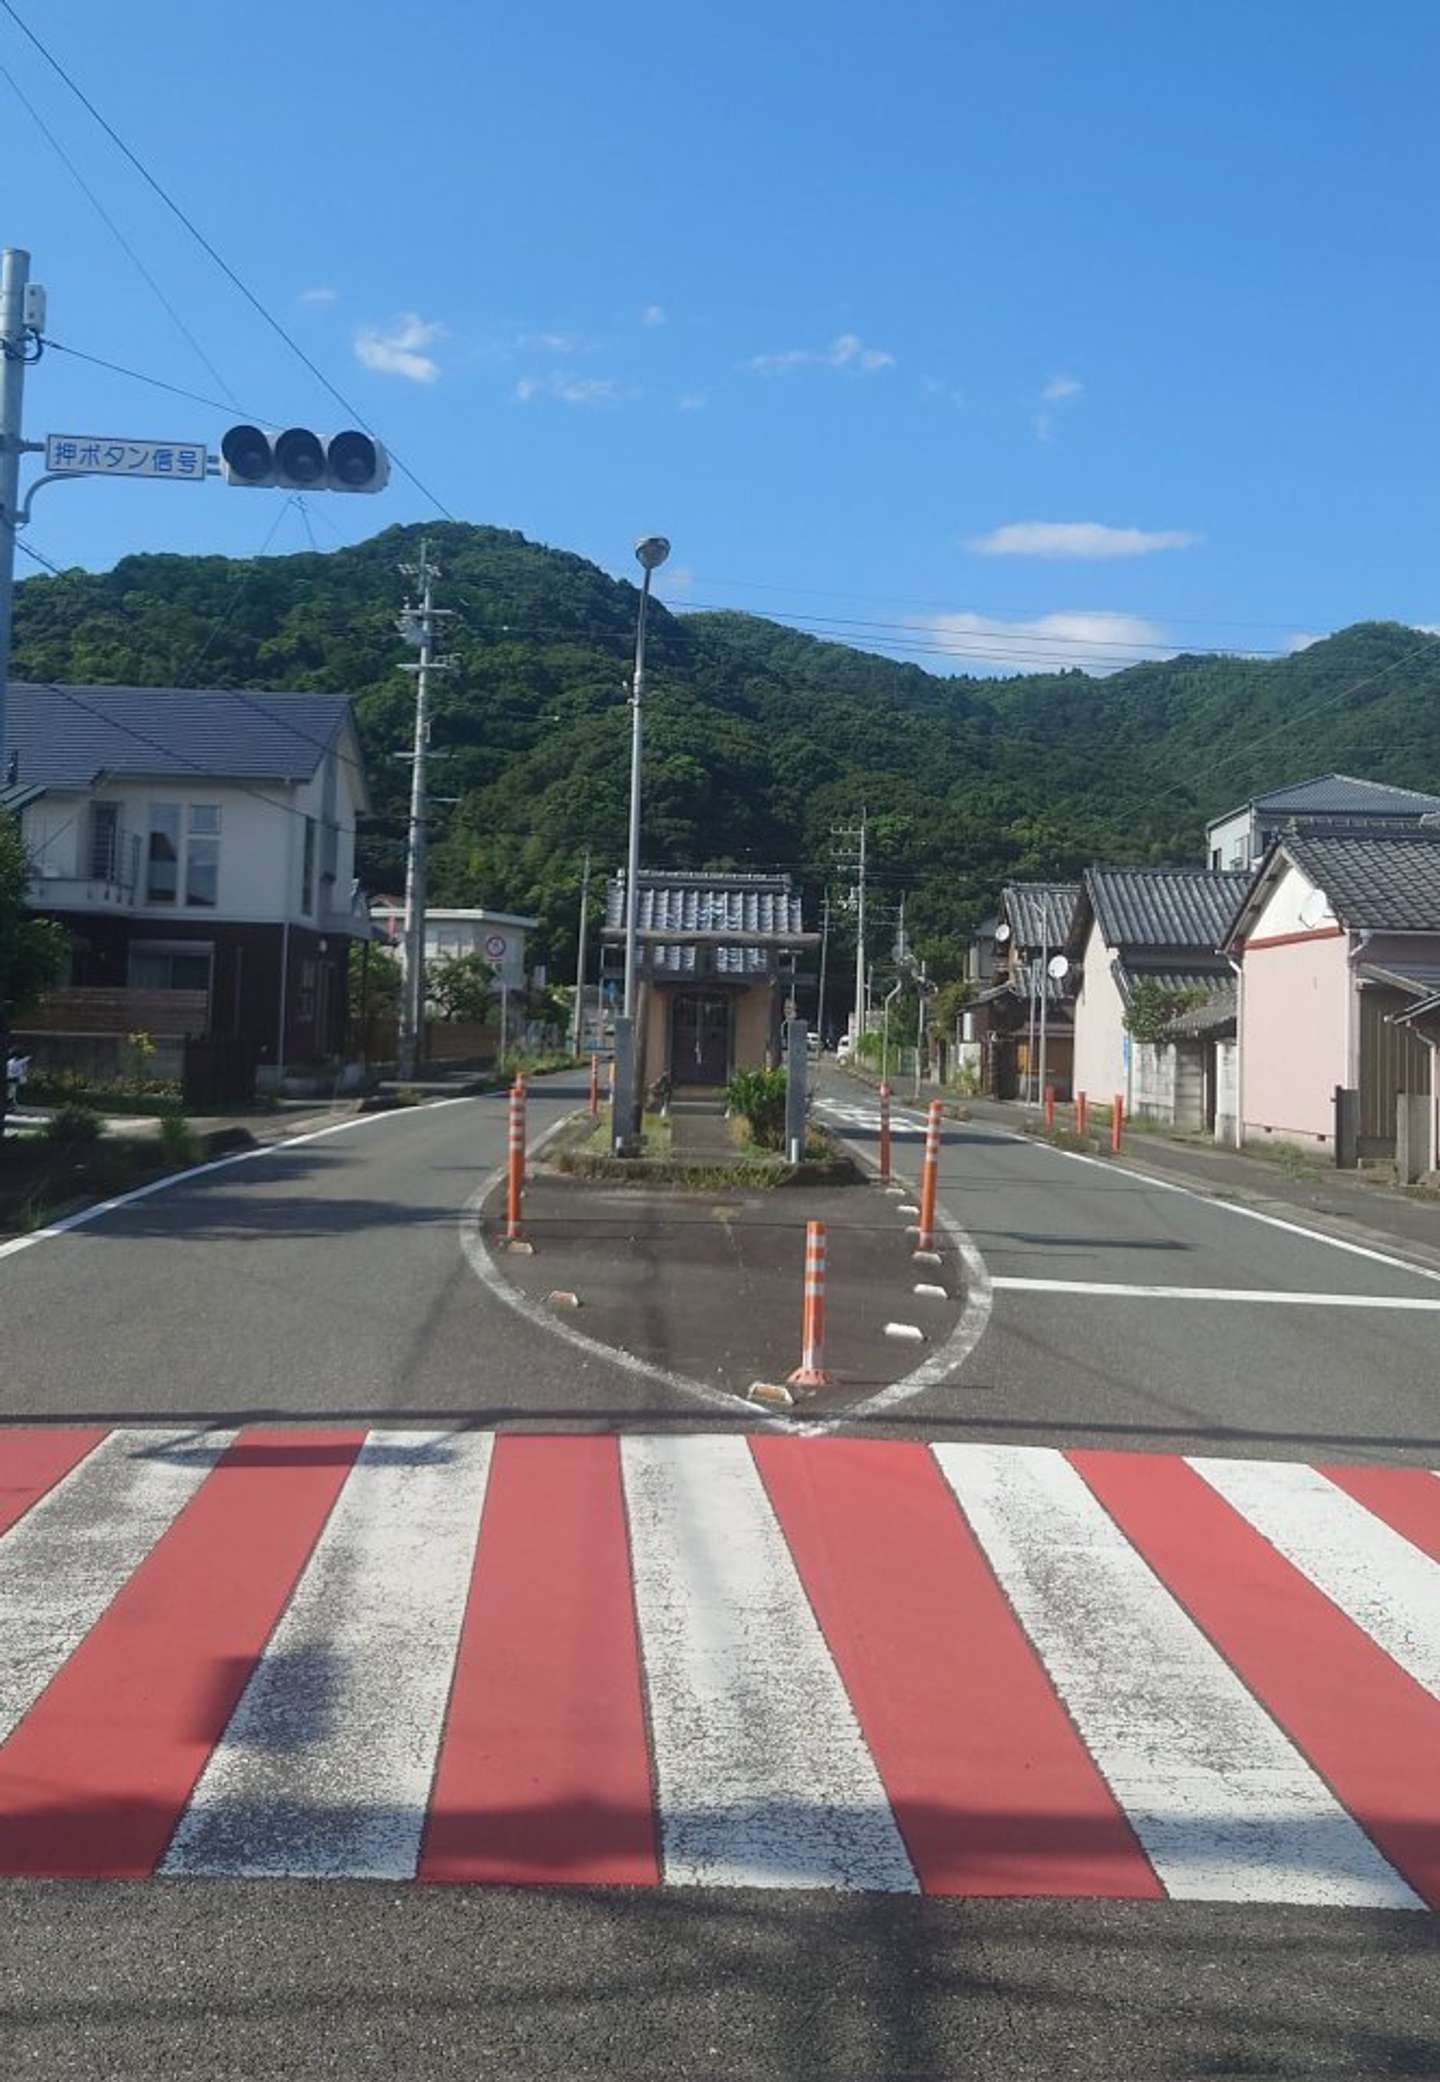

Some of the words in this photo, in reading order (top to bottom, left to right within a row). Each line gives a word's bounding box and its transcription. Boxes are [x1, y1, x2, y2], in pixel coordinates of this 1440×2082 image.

[55, 442, 197, 473] 押ボタン信号
